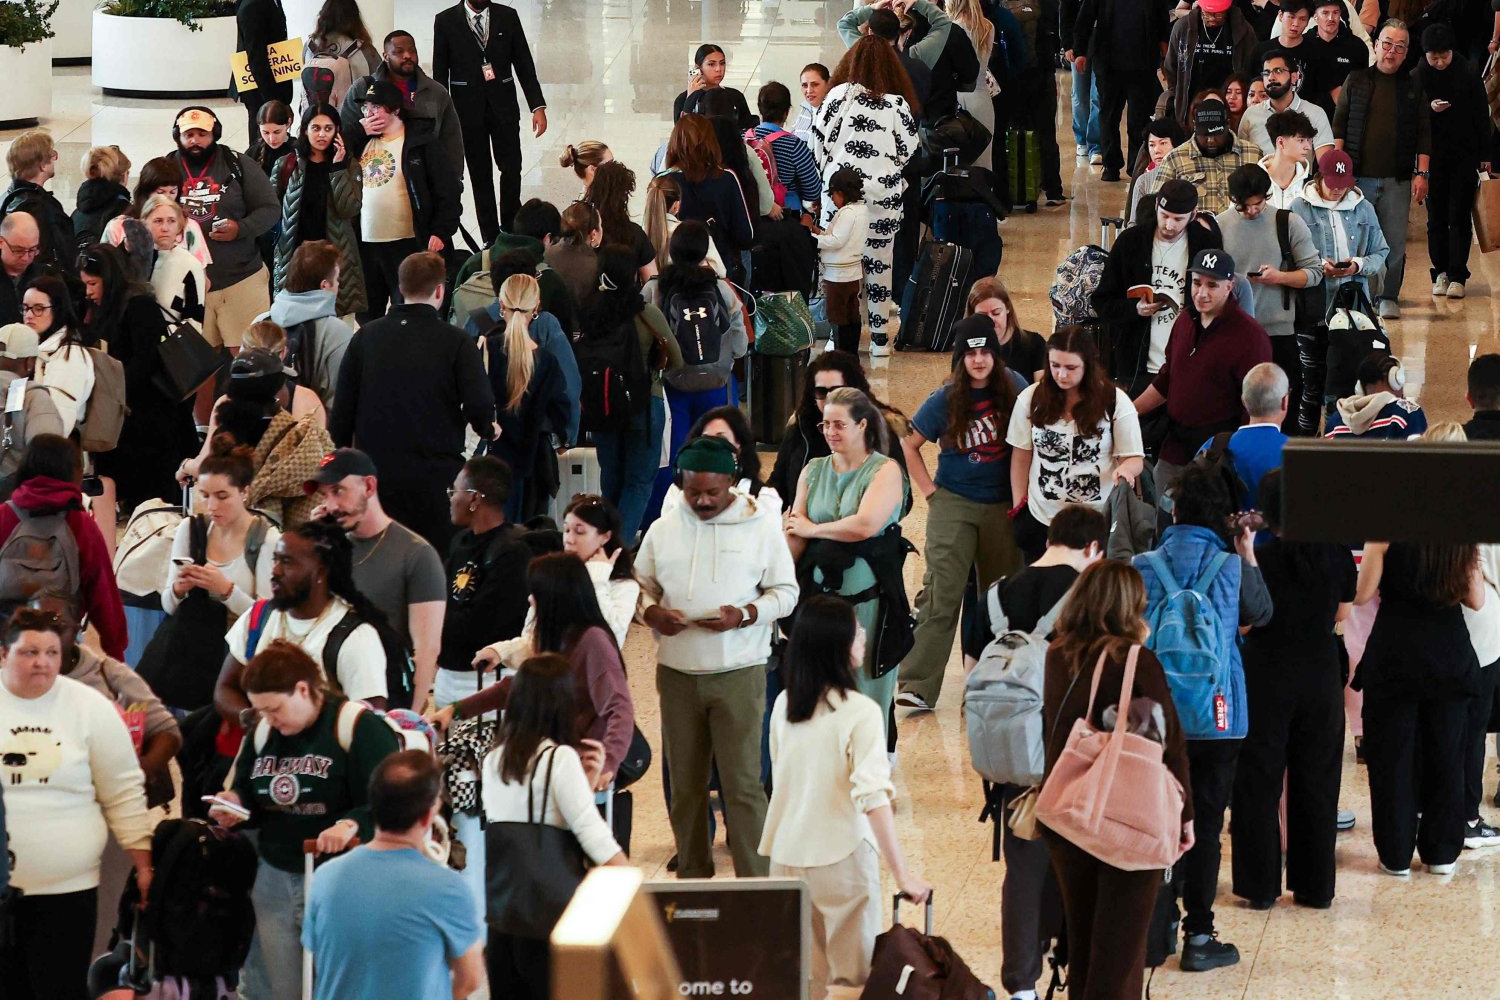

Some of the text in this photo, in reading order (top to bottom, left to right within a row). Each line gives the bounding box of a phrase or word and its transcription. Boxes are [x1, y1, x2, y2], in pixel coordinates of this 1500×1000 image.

[242, 63, 300, 85] SCNING
[1202, 253, 1217, 268] NY
[1216, 700, 1225, 728] CREW
[730, 978, 753, 995] to
